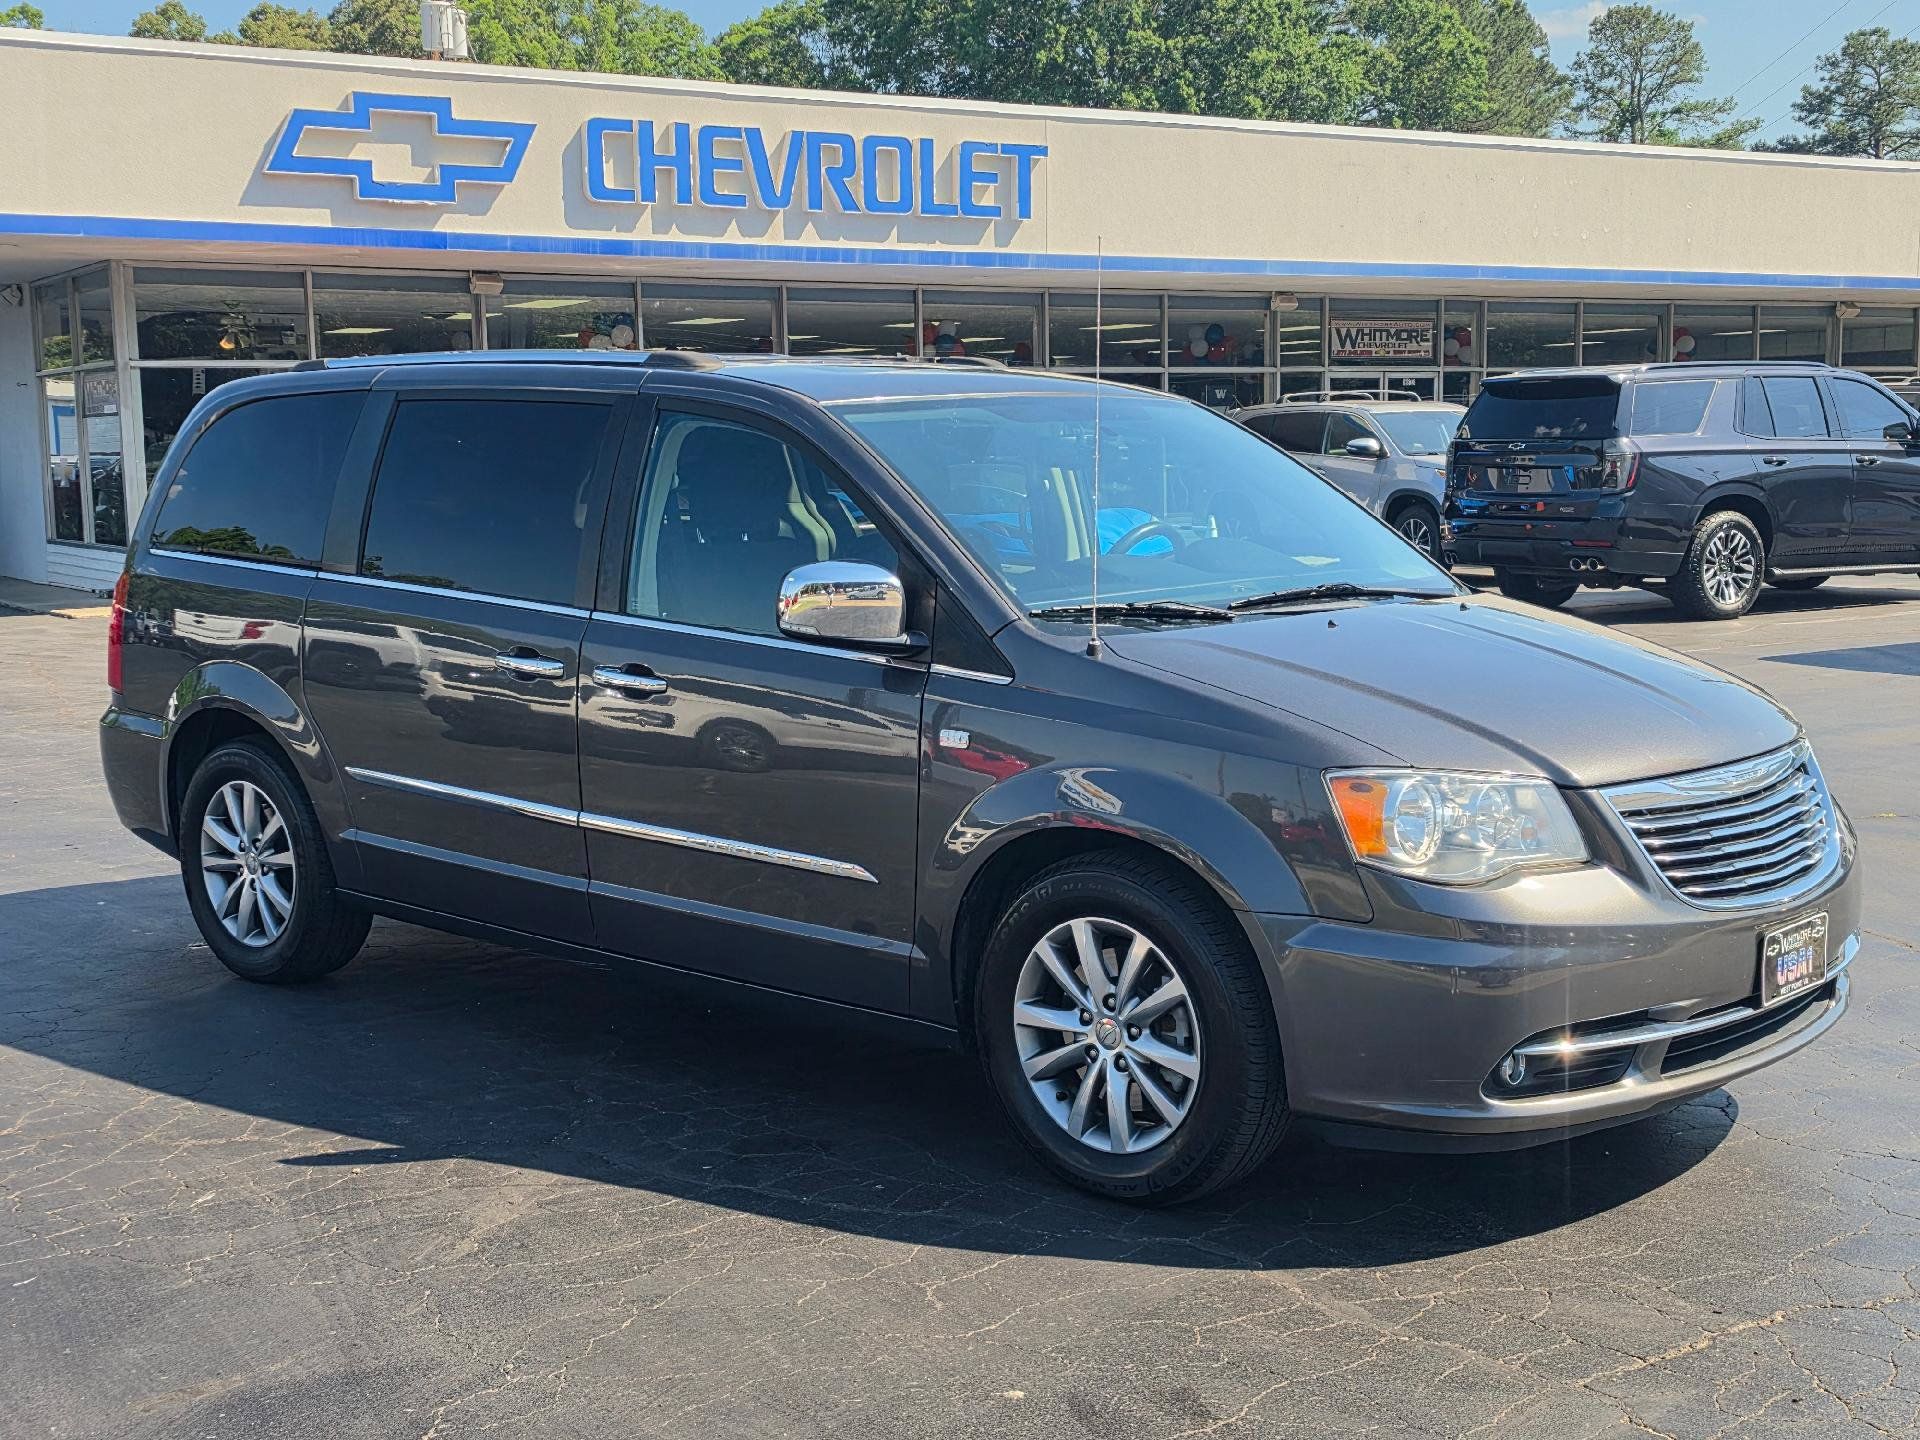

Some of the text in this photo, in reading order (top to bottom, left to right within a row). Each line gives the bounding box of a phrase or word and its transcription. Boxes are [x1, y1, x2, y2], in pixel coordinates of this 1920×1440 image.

[585, 116, 1048, 221] CHEVROLET
[1334, 327, 1430, 349] WHITMORE
[1357, 341, 1408, 349] CHEVROLET
